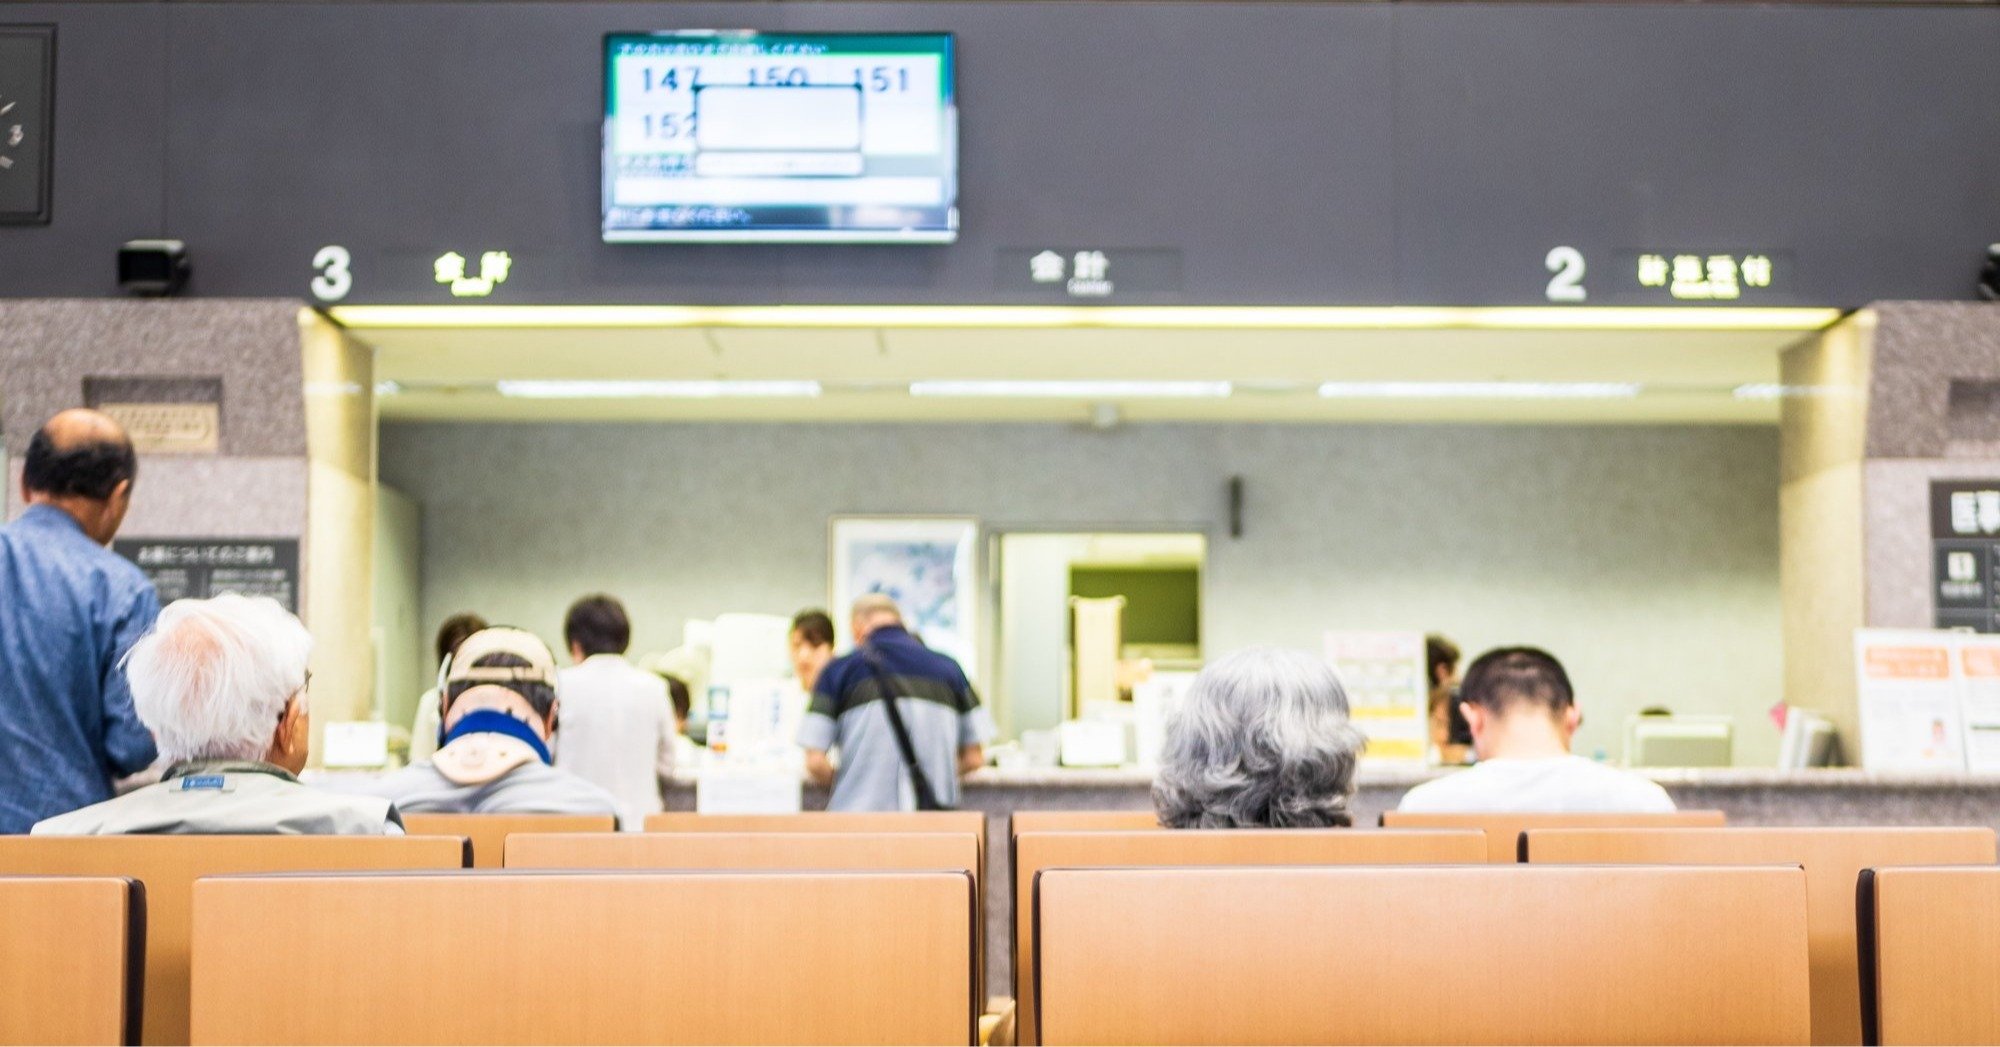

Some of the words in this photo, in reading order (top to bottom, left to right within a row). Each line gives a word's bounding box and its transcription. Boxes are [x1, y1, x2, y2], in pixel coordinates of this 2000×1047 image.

[642, 66, 702, 92] 147
[854, 66, 910, 92] 151
[311, 245, 352, 301] 3
[1030, 250, 1110, 282] 会計
[1545, 246, 1587, 301] 2
